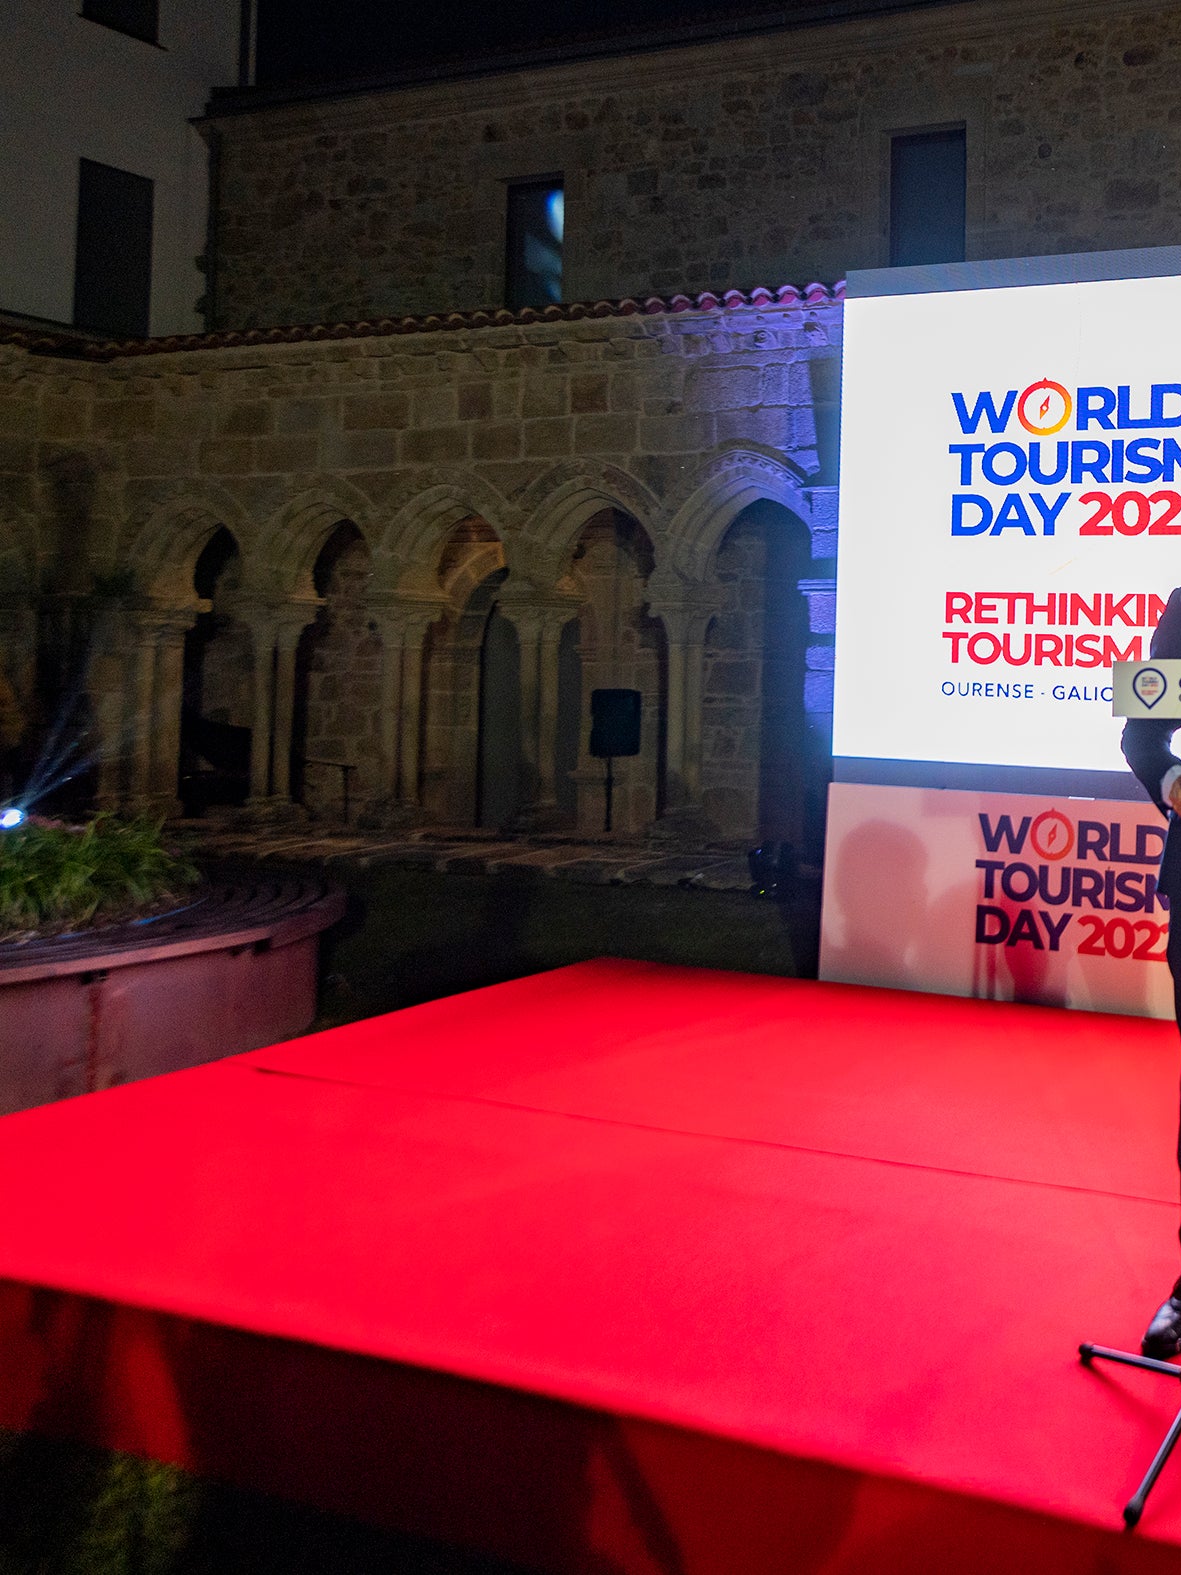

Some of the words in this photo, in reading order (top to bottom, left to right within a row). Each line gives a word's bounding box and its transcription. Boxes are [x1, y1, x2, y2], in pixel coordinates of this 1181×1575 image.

[951, 492, 1071, 536] DAY
[945, 592, 1168, 627] RETHINKIN
[942, 632, 1142, 668] TOURISM
[941, 681, 1034, 699] OURENSE
[1052, 685, 1113, 702] GALIC
[978, 808, 1167, 865] WORLD
[976, 904, 1073, 952] DAY
